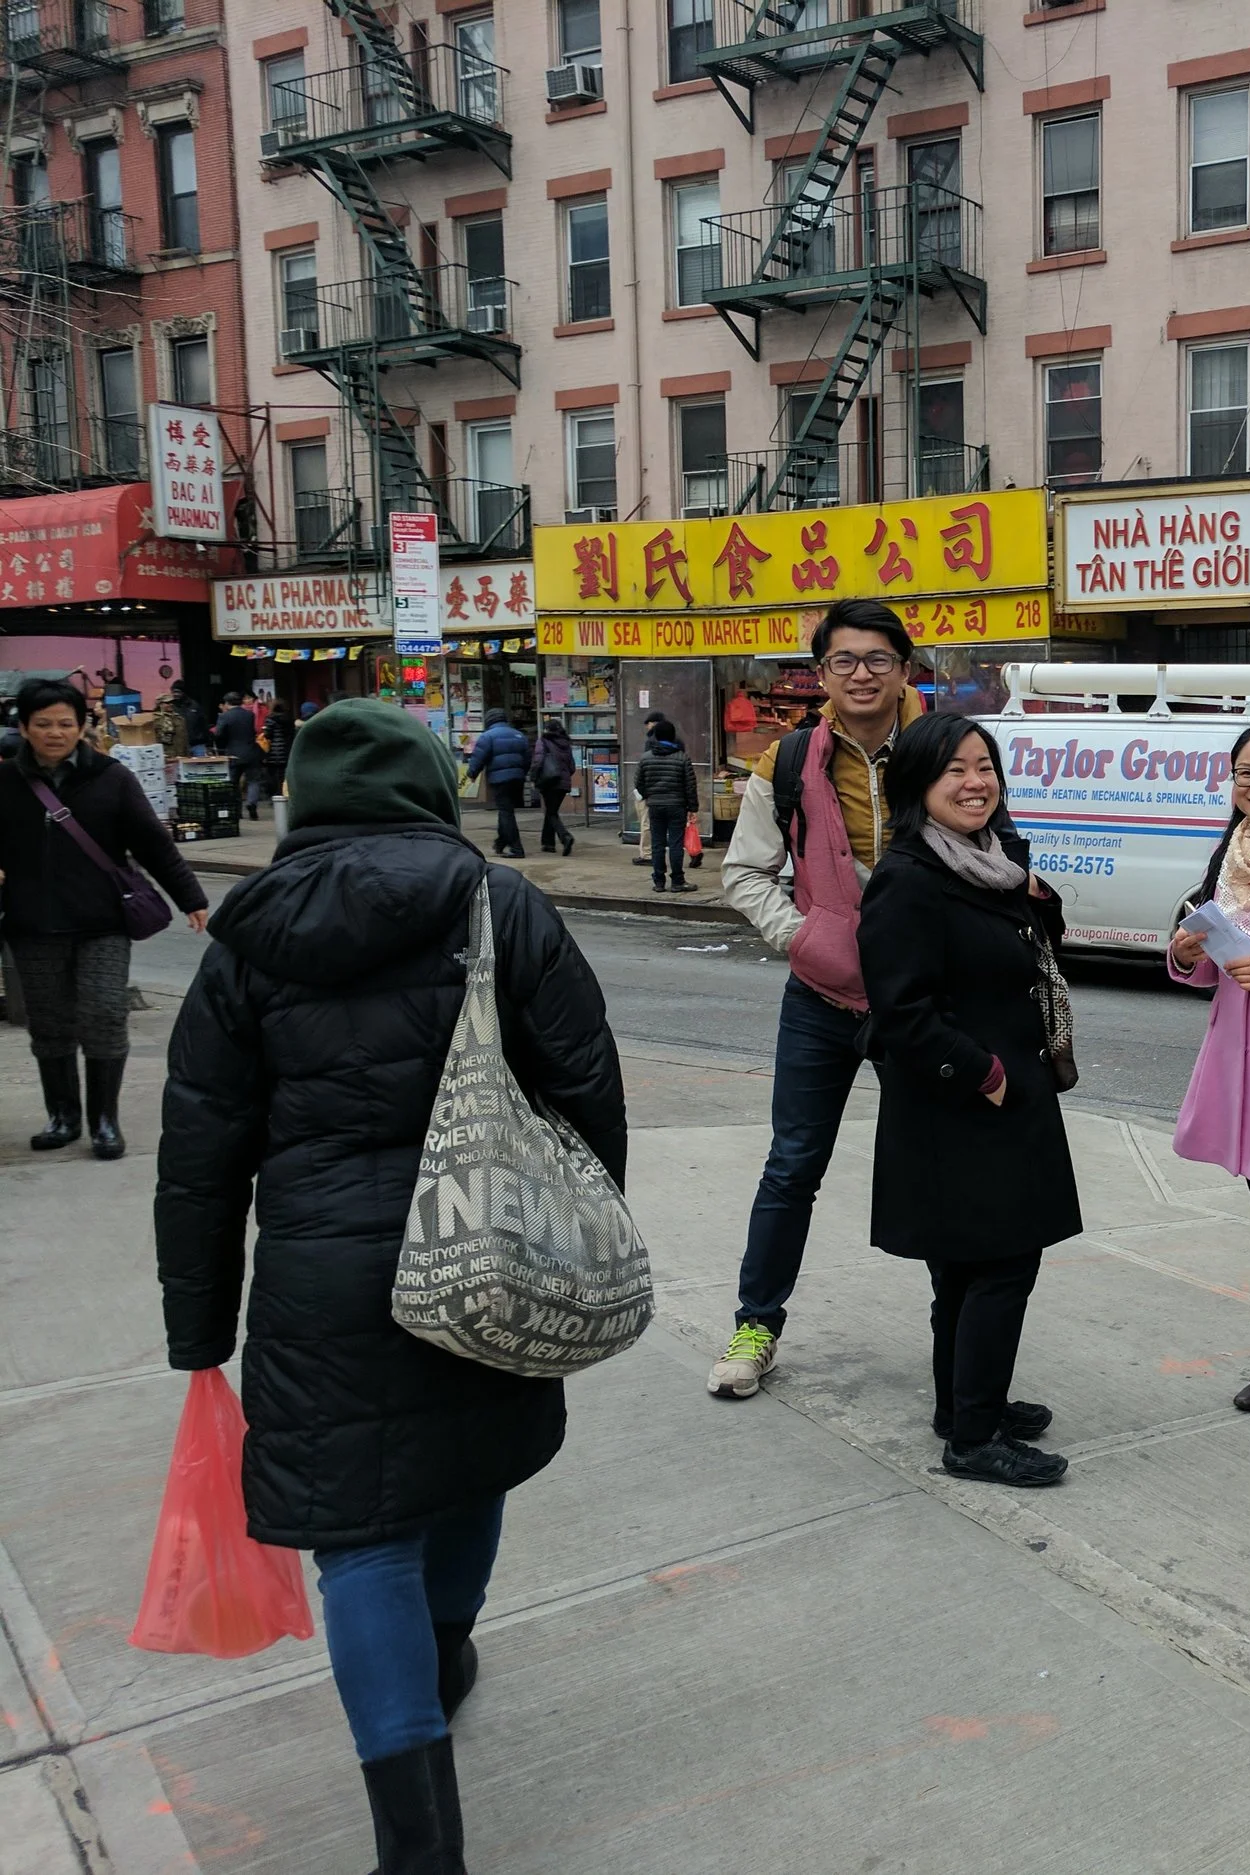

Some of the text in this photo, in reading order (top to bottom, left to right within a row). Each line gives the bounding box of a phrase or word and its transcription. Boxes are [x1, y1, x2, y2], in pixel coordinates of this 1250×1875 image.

[171, 480, 196, 504] BAC
[167, 505, 221, 531] PHARMACY
[1093, 505, 1241, 549] NHÀ HÀNG
[573, 502, 992, 604] 劉氏食品公司
[1076, 553, 1127, 593] TÂN
[225, 577, 369, 611] BAC AI PHARMACY
[250, 609, 338, 631] PHARMACO
[342, 608, 374, 628] INC.
[1015, 599, 1041, 629] 218
[543, 621, 564, 646] 218
[578, 621, 605, 647] WIN
[613, 621, 641, 646] SEA
[656, 619, 694, 647] FOOD
[702, 618, 760, 647] MARKET
[768, 616, 799, 644] INC.
[1008, 737, 1232, 793] Taylor Group
[1008, 787, 1226, 806] PLUMBING HEATING MECHANICAL & SPRINKLER, INC.
[1025, 831, 1122, 849] Quality Is Important
